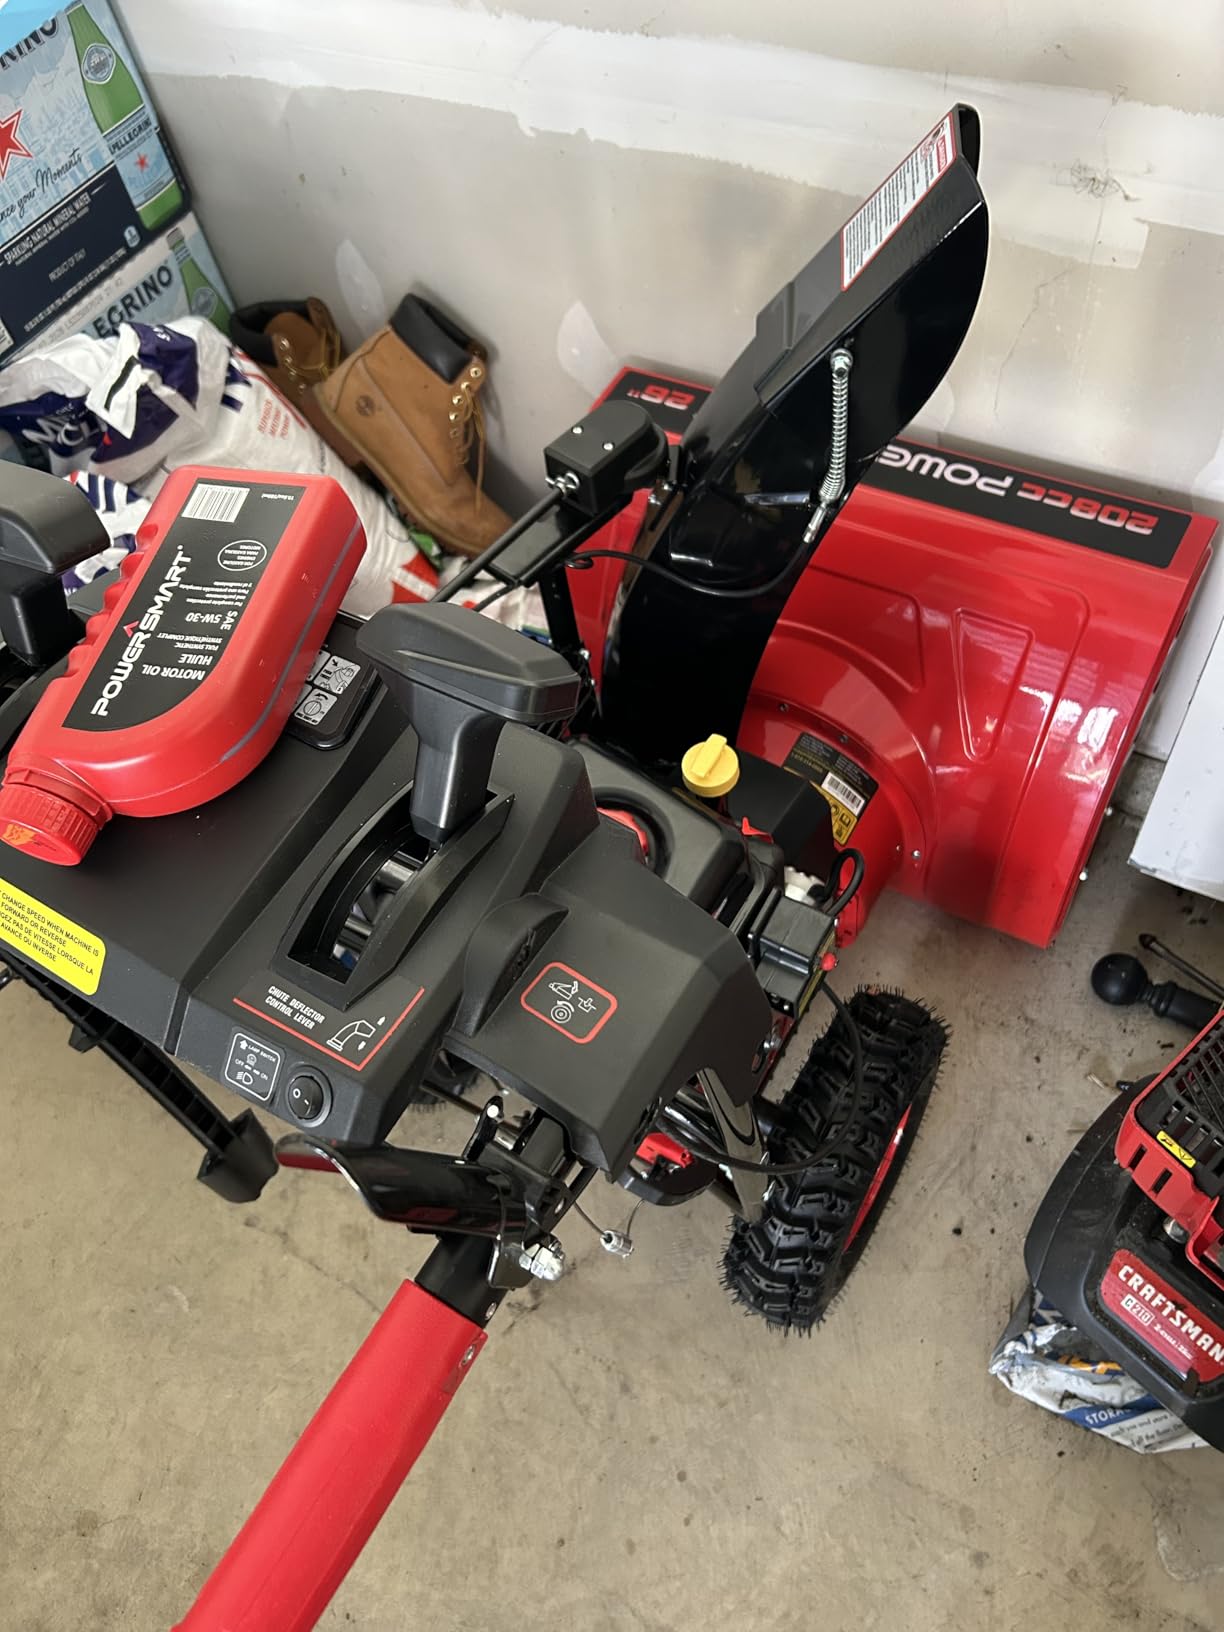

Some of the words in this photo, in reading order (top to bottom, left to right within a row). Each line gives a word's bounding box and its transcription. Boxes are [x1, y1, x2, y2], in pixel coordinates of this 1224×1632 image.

[17, 187, 36, 219] your
[36, 147, 82, 193] Moments
[30, 220, 56, 244] NATURAL
[52, 203, 77, 228] MINERAL
[73, 191, 91, 211] WATER
[93, 265, 172, 338] EGRINO
[877, 444, 1015, 497] POWE
[1016, 480, 1160, 536] 208cc
[90, 547, 192, 717] POWERSMART
[185, 611, 223, 624] 5W-30
[220, 610, 239, 631] SAE
[174, 642, 206, 651] SYNTHETIC
[177, 653, 214, 666] HUILE
[205, 643, 219, 651] FULL
[141, 663, 161, 676] OIL
[161, 666, 206, 681] MOTOR
[0, 921, 23, 940] AVANCE
[23, 936, 32, 946] OU
[32, 941, 57, 962] INVERSE
[0, 910, 12, 924] GEZ
[12, 920, 24, 931] PAS
[24, 927, 32, 936] DE
[33, 932, 56, 952] VITESSE
[56, 947, 85, 970] LORSQUE
[85, 965, 94, 975] LA
[1, 901, 29, 925] FORWARD
[29, 919, 39, 930] OR
[39, 925, 67, 947] REVERSE
[1, 892, 27, 911] CHANGE
[27, 907, 46, 924] SPEED
[46, 920, 64, 935] WHEN
[65, 931, 94, 953] MACHINE
[92, 948, 100, 957] IS
[265, 995, 294, 1017] CONTROL
[293, 1012, 316, 1030] LEVER
[267, 985, 291, 1003] CHUTE
[290, 998, 326, 1024] DEFLECTOR
[260, 1072, 269, 1081] ON
[1118, 1264, 1224, 1363] CRAFTSMAN
